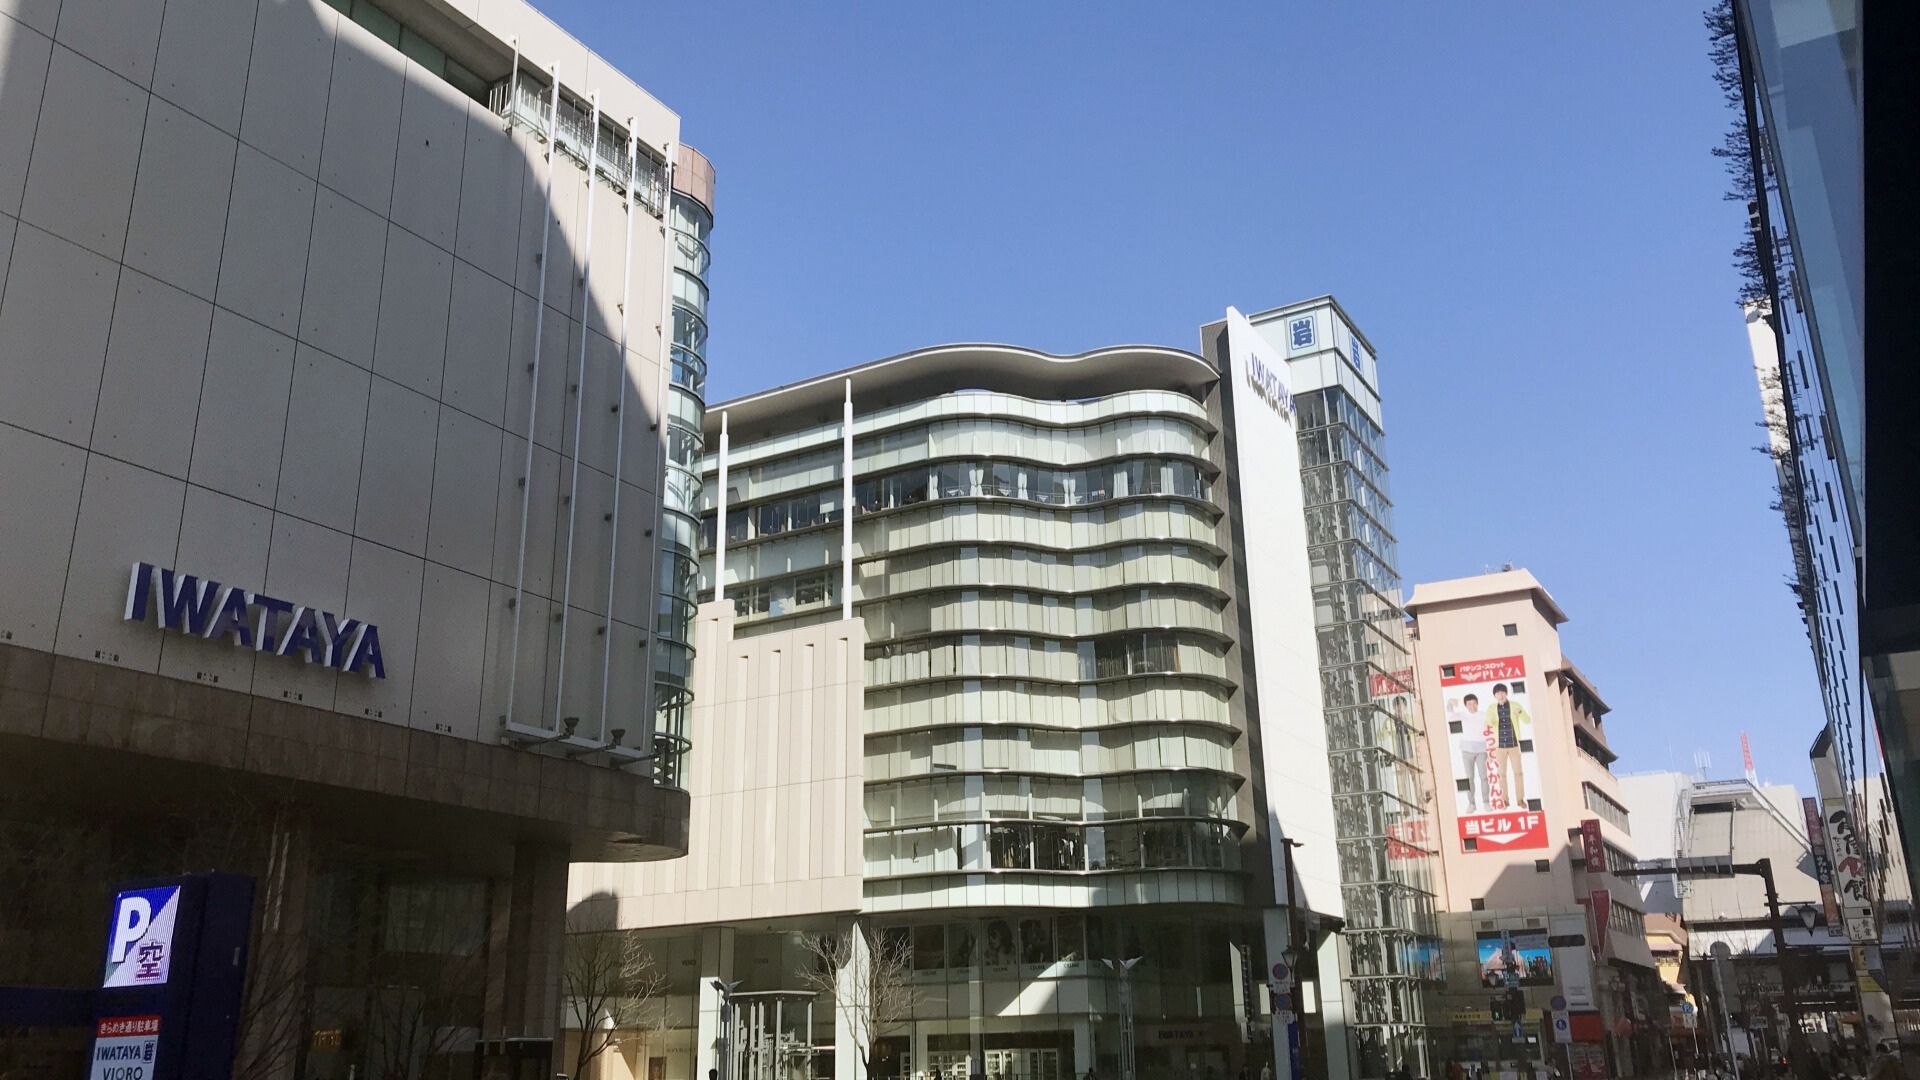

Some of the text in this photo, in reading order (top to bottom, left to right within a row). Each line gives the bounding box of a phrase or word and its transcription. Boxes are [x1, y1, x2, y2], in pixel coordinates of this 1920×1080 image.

[1251, 352, 1296, 414] IWATAYA
[124, 561, 385, 679] IWATAYA
[1482, 667, 1521, 681] PLAZA
[1465, 816, 1539, 835] 当ビル 1F
[112, 896, 151, 963] P
[136, 941, 164, 979] 空
[100, 1019, 159, 1034] きらめき通り駐車場
[96, 1045, 141, 1061] IWATAYA
[103, 1067, 143, 1080] VIORO
